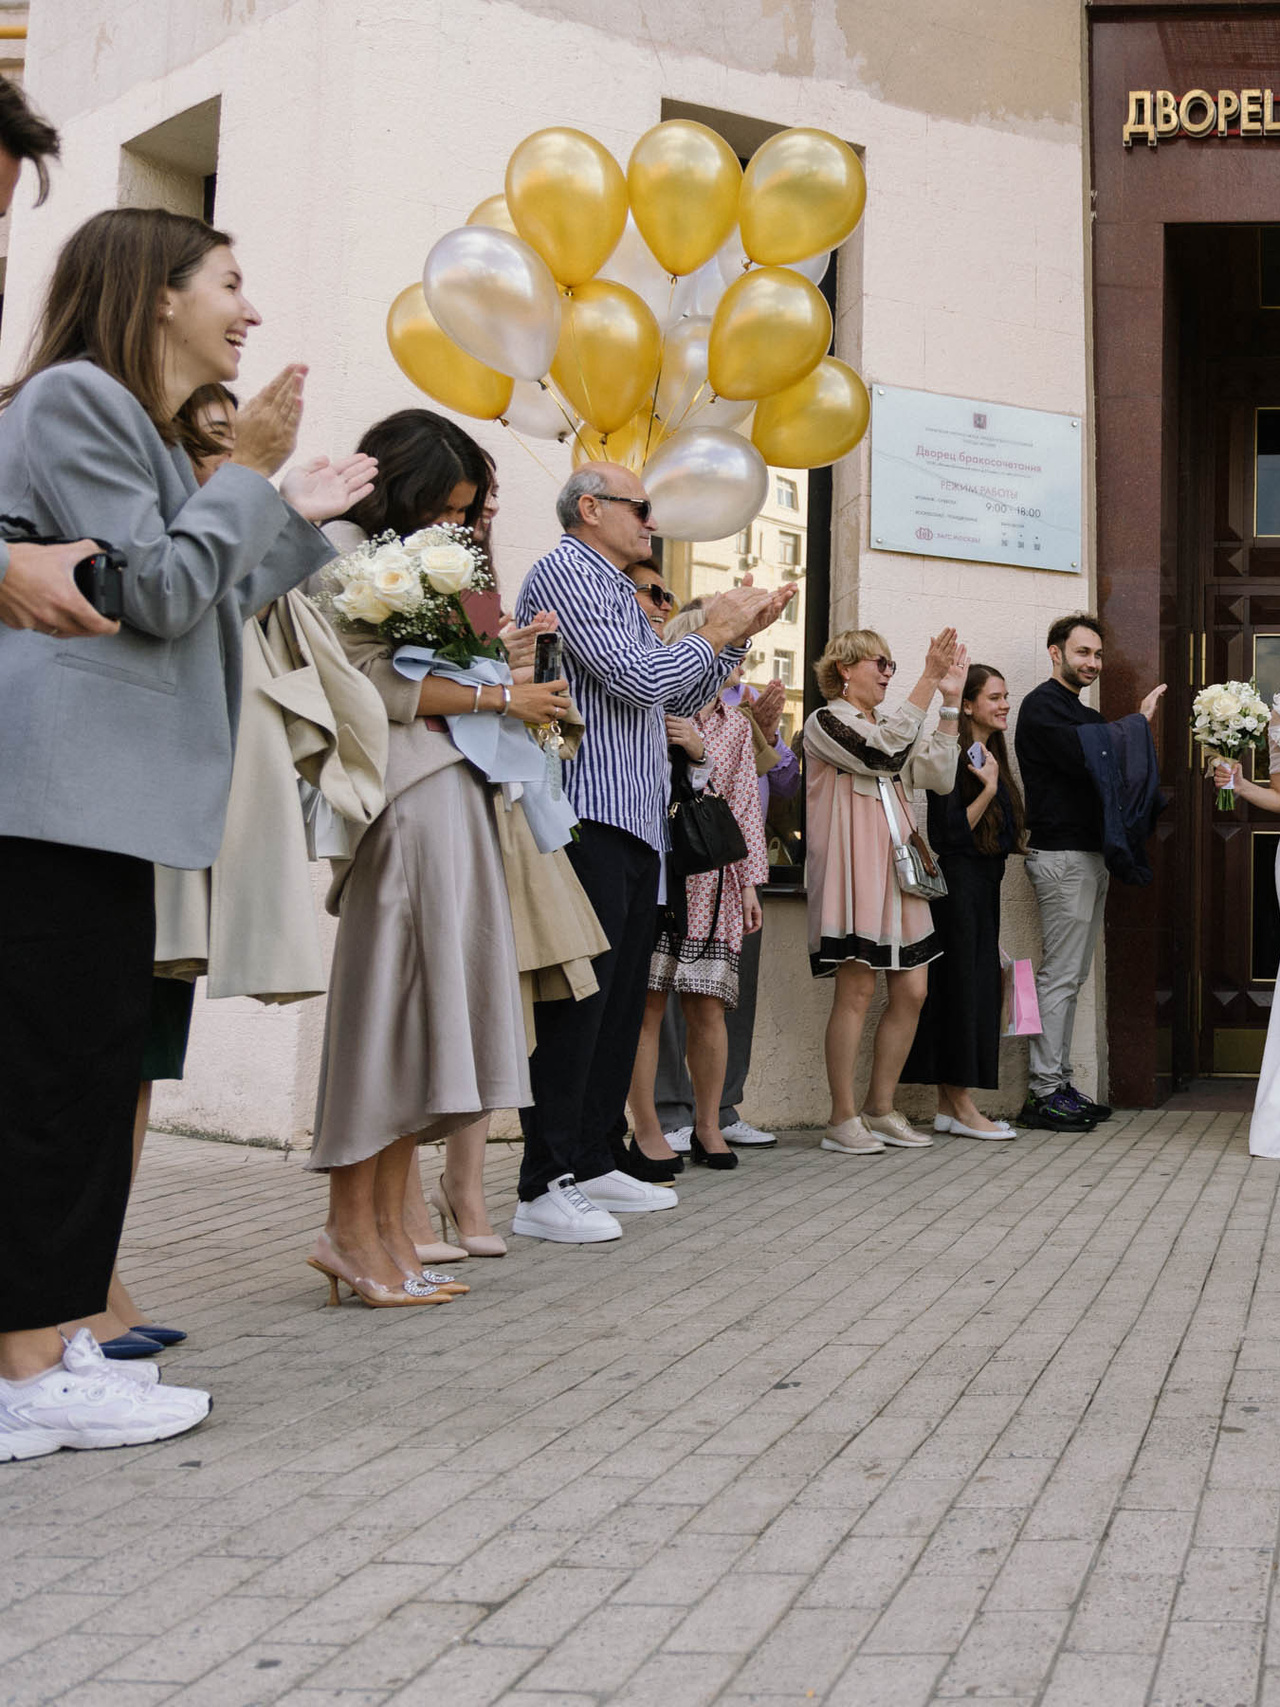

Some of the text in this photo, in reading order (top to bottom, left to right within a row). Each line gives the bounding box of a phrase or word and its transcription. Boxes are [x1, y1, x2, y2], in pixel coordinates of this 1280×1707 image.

[916, 445, 957, 461] Дворец
[959, 452, 1042, 473] бракосочетания
[940, 480, 978, 494] РЕЖИМ
